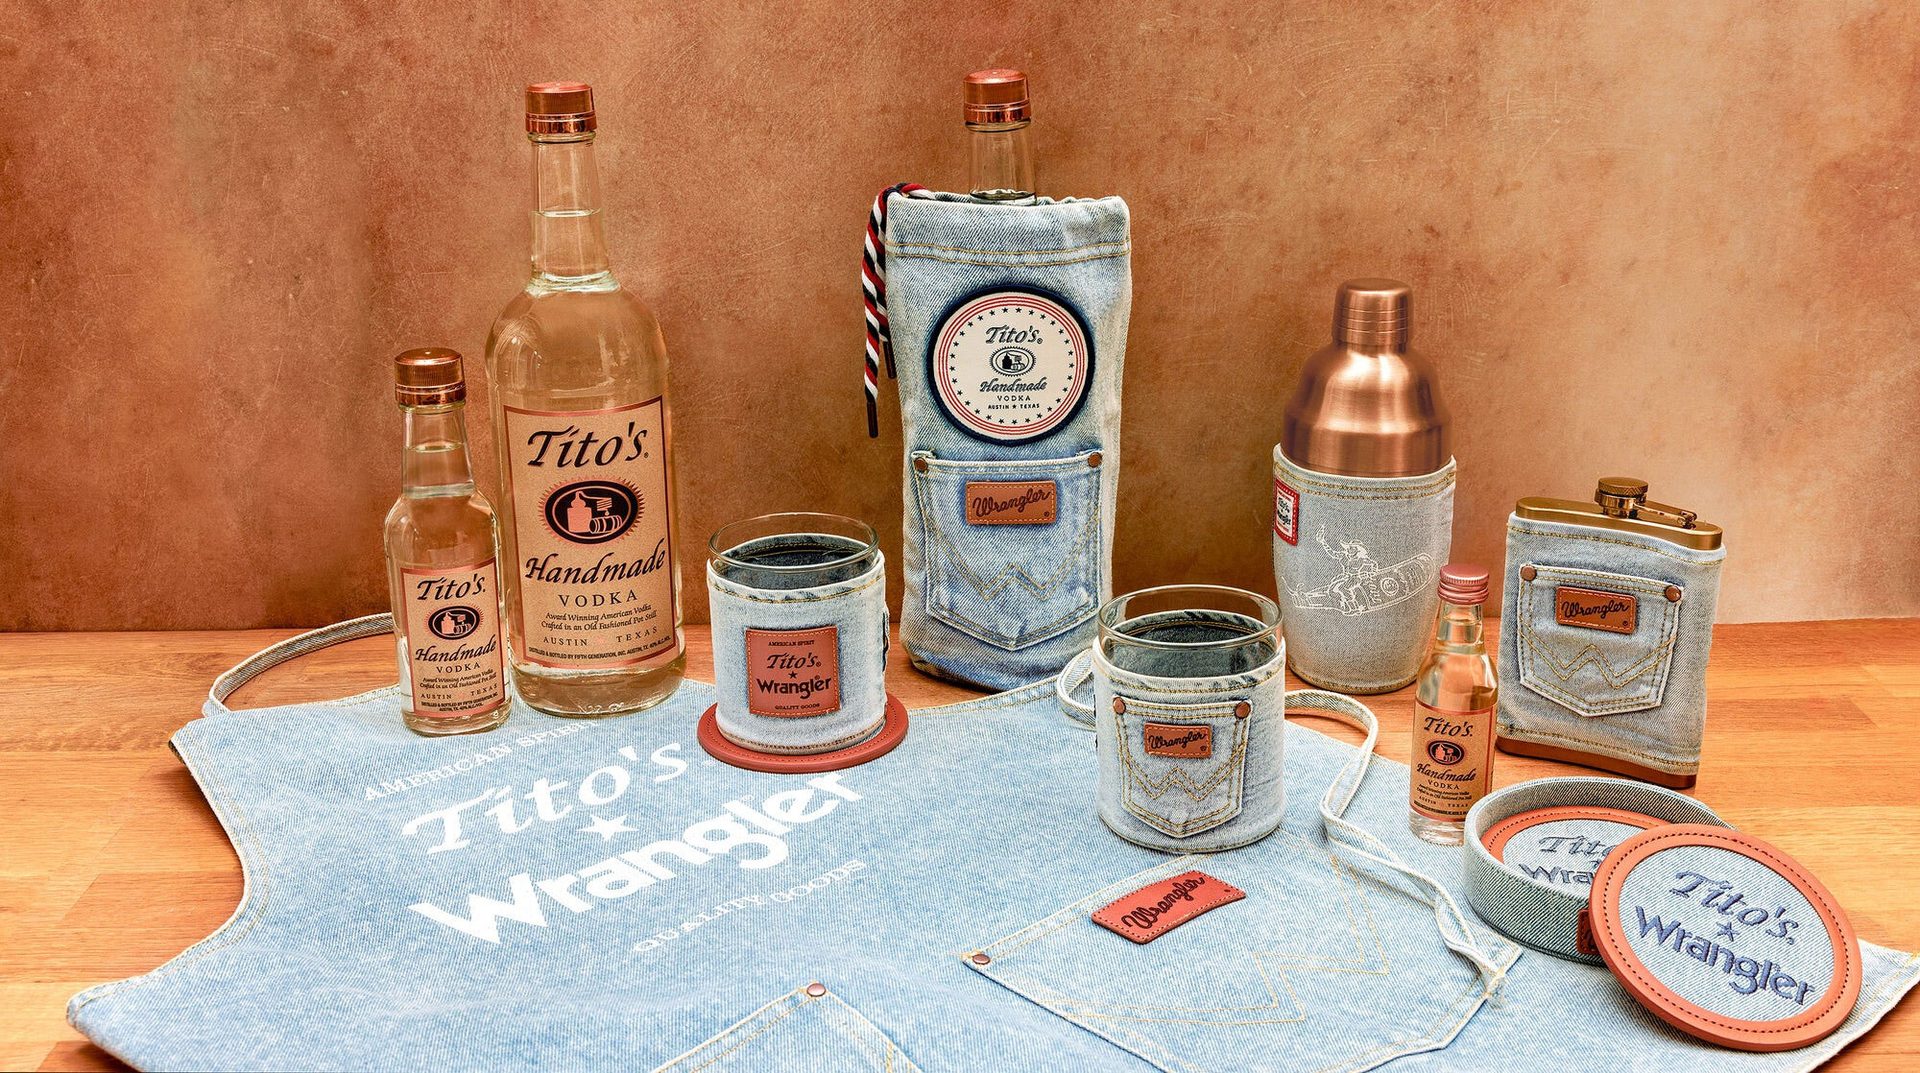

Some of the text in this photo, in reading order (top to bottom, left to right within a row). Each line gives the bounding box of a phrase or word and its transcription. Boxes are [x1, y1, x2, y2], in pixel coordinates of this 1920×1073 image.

[985, 324, 1040, 344] Tito's
[979, 376, 1048, 393] Handmade
[527, 421, 649, 468] Tito's
[972, 488, 1052, 518] Wrangler
[525, 537, 666, 585] Handmade
[416, 573, 486, 600] Tito's
[558, 589, 638, 608] VODKA
[1561, 599, 1631, 619] Wrangler
[541, 620, 563, 631] Crafted
[584, 622, 598, 631] Old
[599, 617, 632, 631] Fashioned
[545, 603, 652, 623] Award Winning American Vodka
[543, 625, 658, 646] AUSTIN TEXAS
[415, 634, 497, 663] Handmade
[436, 661, 481, 674] VODKA
[766, 652, 818, 670] Tito's
[470, 683, 498, 697] TEXAS
[755, 677, 832, 700] Wrangler
[1423, 716, 1474, 737] Tito's
[1149, 727, 1208, 750] Wrangler
[364, 720, 601, 801] AMERICAN SPIRIT
[1416, 763, 1477, 782] Handmade
[1427, 780, 1460, 790] VODKA
[400, 742, 688, 854] Tito's
[405, 773, 864, 944] Wrangler
[633, 859, 867, 952] QUALITY GOODS
[1120, 876, 1207, 930] Wrangler
[1669, 870, 1799, 940] Tito's
[1635, 905, 1816, 1006] Wrangler
